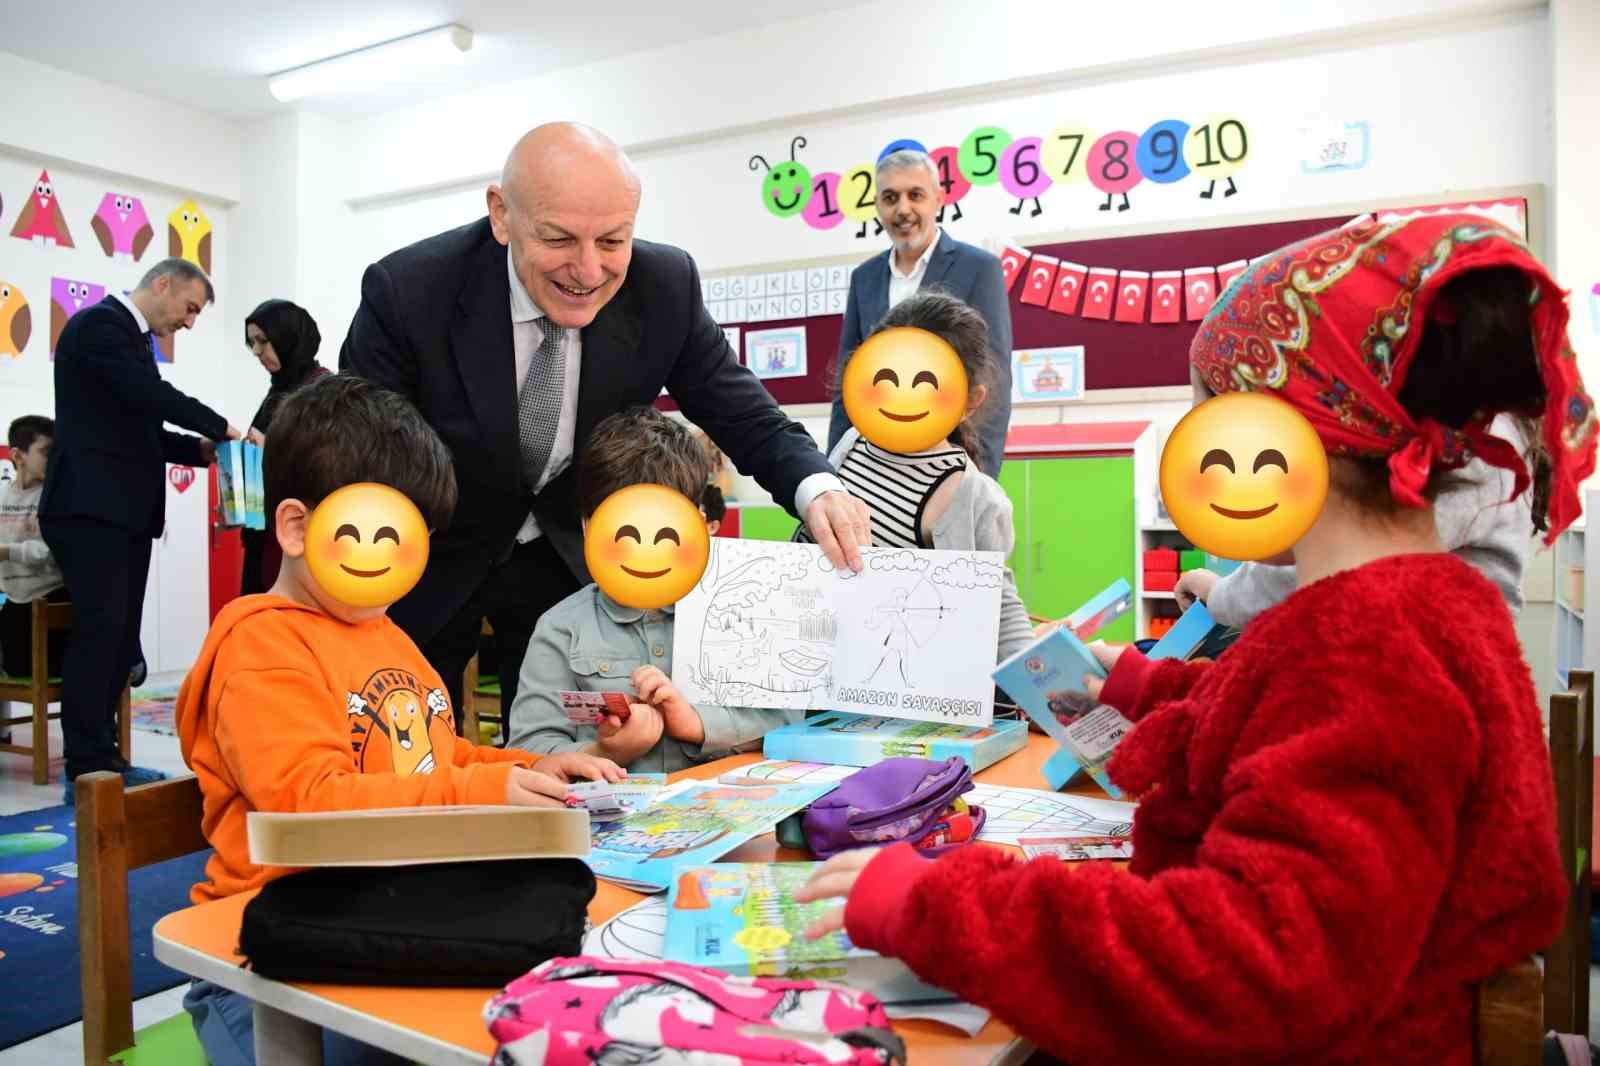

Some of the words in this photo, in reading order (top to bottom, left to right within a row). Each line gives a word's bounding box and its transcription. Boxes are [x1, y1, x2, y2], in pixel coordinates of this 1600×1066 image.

[814, 180, 838, 217] 1
[851, 171, 875, 208] 2
[937, 155, 955, 194] 4
[972, 135, 997, 177] 5
[1013, 144, 1039, 186] 6
[1058, 134, 1084, 175] 7
[1102, 140, 1129, 181] 8
[1151, 129, 1178, 174] 9
[1193, 119, 1248, 167] 10
[837, 688, 898, 706] AMAZON
[903, 694, 983, 717] SAVAŞÇISI
